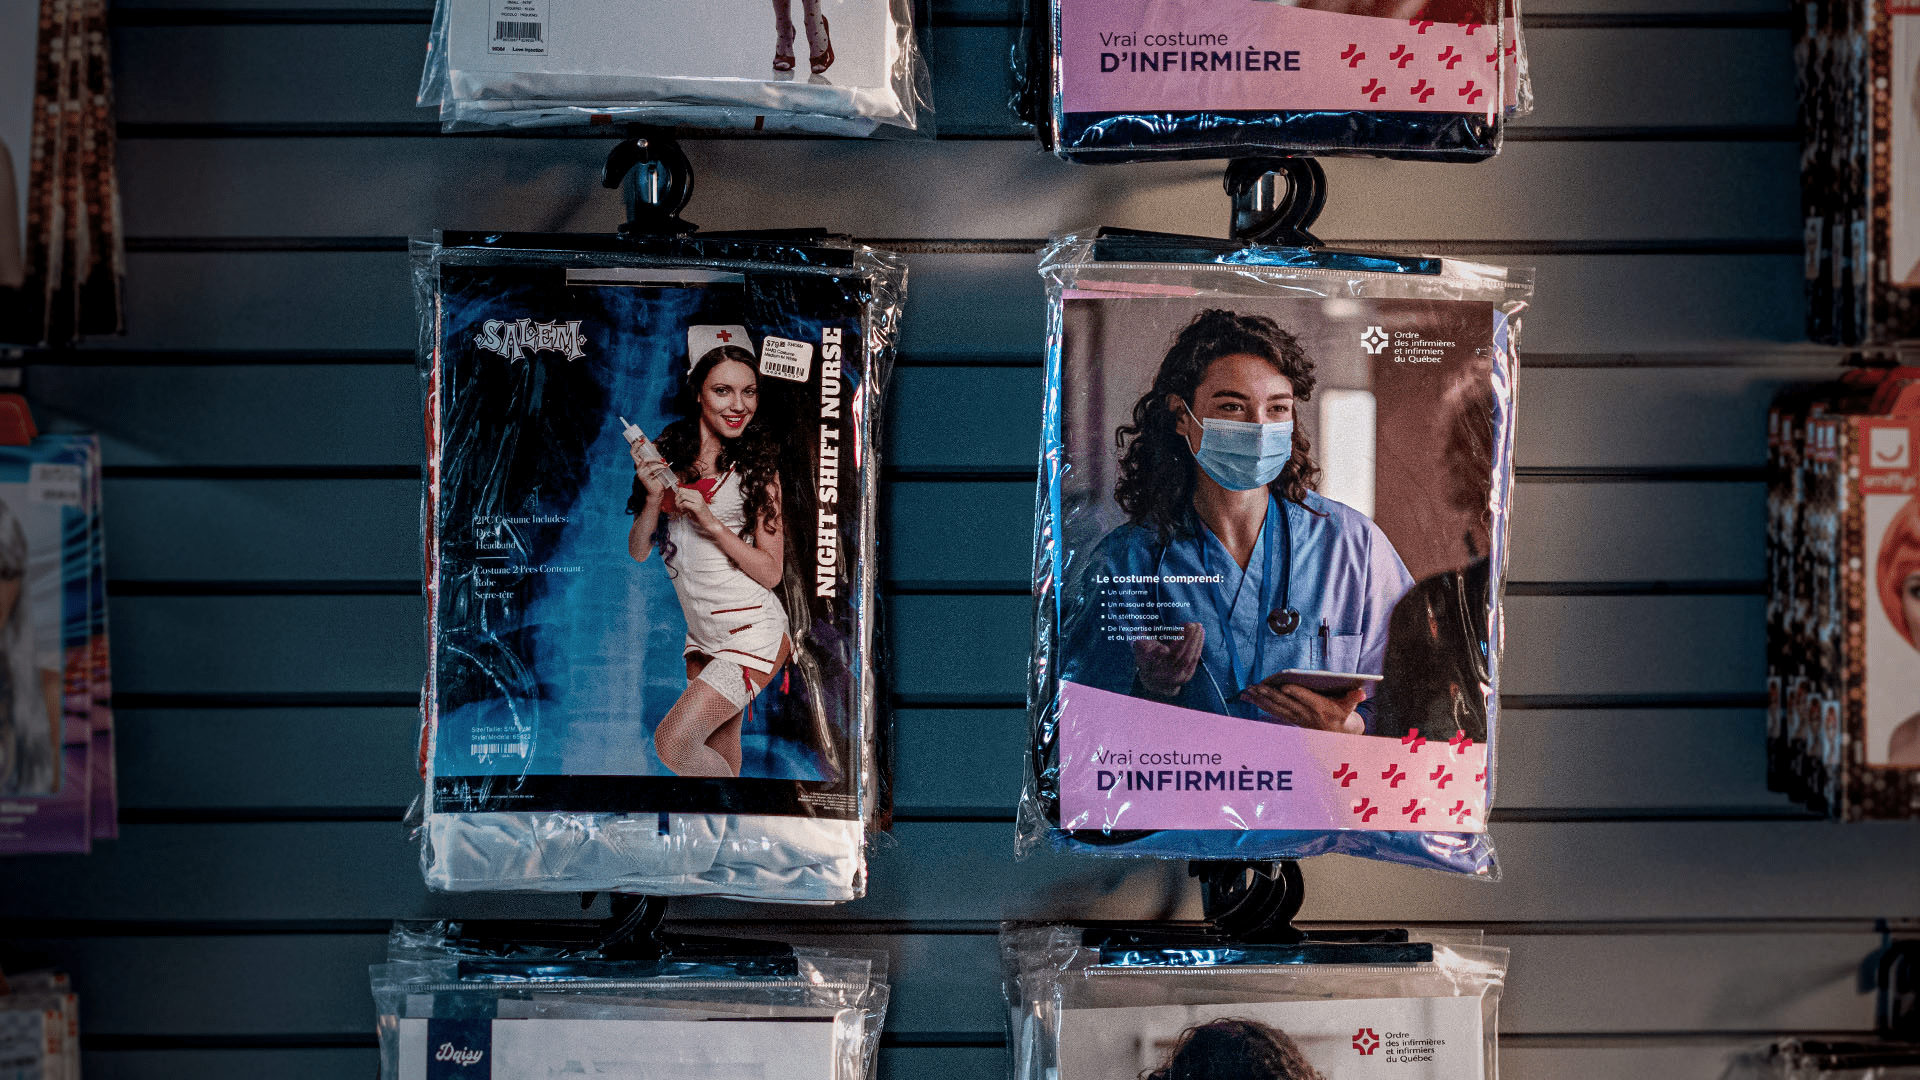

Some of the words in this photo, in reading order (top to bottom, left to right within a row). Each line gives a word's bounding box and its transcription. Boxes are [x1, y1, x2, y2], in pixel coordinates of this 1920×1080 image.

[1100, 31, 1137, 47] Vrai
[1144, 31, 1228, 47] costume
[1394, 331, 1420, 339] Ordre
[474, 318, 588, 364] SALEM
[1411, 339, 1456, 348] infirmières
[1405, 348, 1444, 356] infirmiers
[1394, 355, 1406, 363] du
[1408, 355, 1442, 364] Québec
[821, 327, 842, 419] NURSE
[818, 424, 840, 504] SHIFT
[532, 514, 569, 524] Includes:
[476, 540, 516, 550] Headband
[816, 508, 837, 598] NIGHT
[474, 565, 511, 575] Costume
[512, 565, 519, 574] 2
[475, 578, 497, 587] Robe
[1096, 574, 1110, 584] Le
[1112, 574, 1160, 583] costume
[1156, 601, 1191, 609] procédure
[1118, 613, 1159, 621] stéthoscope
[1126, 634, 1158, 642] jugement
[1097, 751, 1132, 765] Vrai
[1139, 751, 1222, 765] costume
[1402, 1038, 1446, 1047] infirmières
[435, 1041, 484, 1067] Daisy
[1386, 1055, 1398, 1063] du
[1400, 1055, 1433, 1063] Québec
